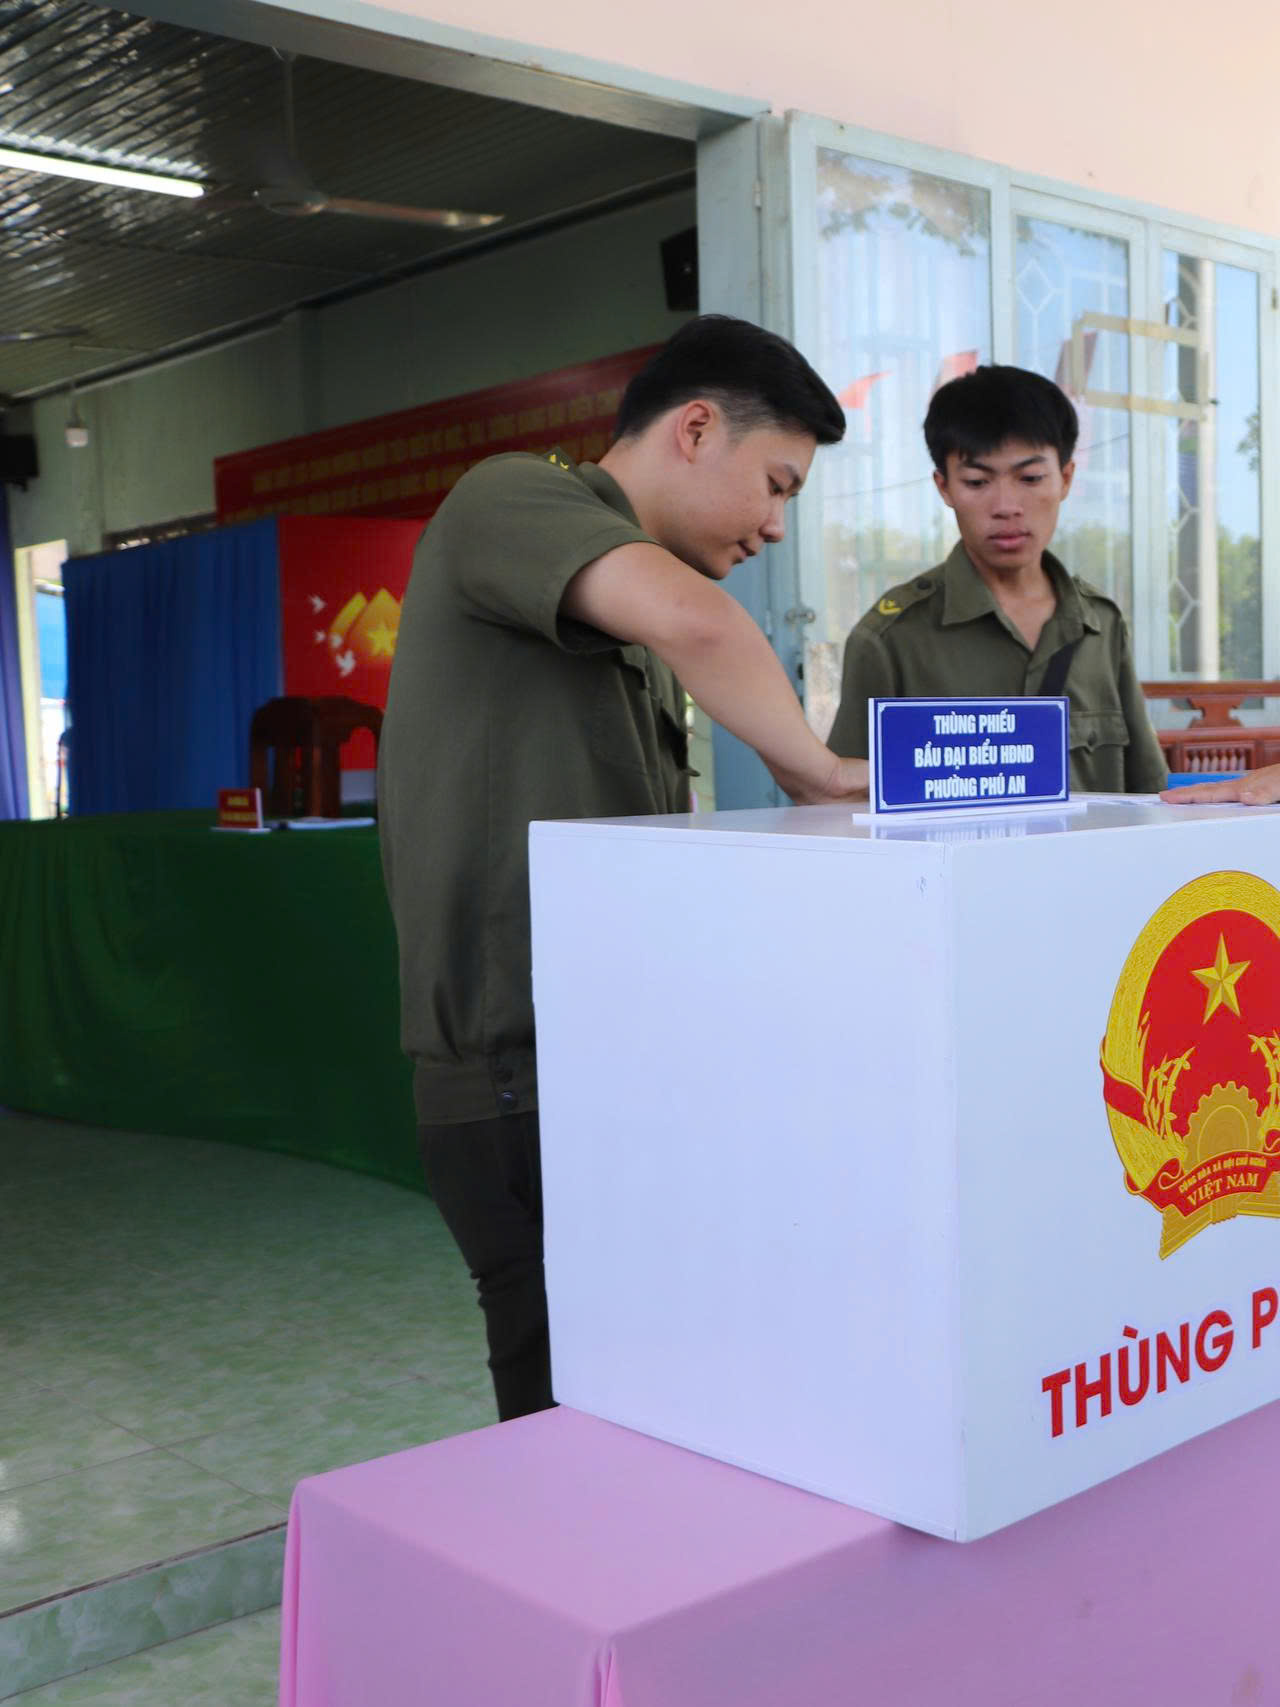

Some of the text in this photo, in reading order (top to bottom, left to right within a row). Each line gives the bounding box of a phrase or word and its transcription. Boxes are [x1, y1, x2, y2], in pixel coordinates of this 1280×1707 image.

[933, 708, 1015, 735] THÙNG PHIẾU
[914, 738, 1034, 770] BẦU ĐẠI BIỂU HĐND
[924, 772, 1026, 799] PHƯỜNG PHÚ AN
[1186, 1172, 1259, 1206] VIỆT NAM
[1042, 1310, 1234, 1438] THÙNG
